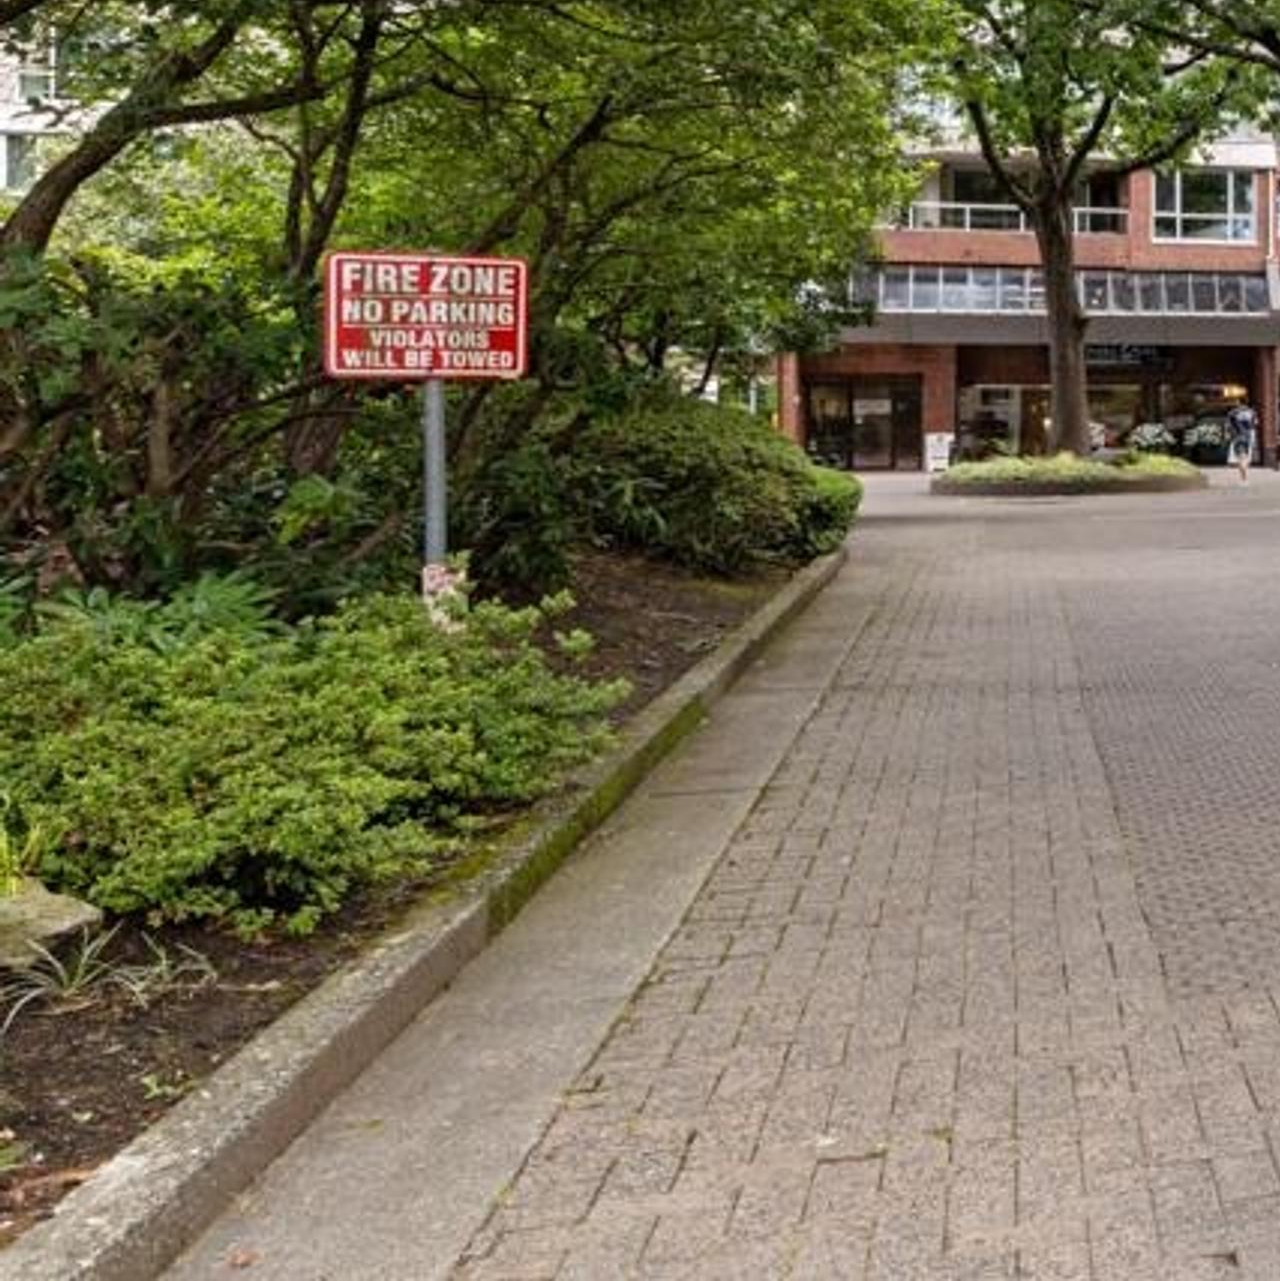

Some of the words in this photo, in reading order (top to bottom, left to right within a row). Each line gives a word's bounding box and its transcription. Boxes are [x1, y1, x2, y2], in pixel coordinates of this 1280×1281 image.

[341, 262, 421, 292] FIRE
[429, 263, 516, 295] ZONE
[341, 300, 384, 321] NO
[392, 301, 515, 326] PARKING
[369, 330, 491, 349] VIOLATORS
[341, 350, 400, 368] WILL
[404, 351, 434, 367] BE
[439, 352, 515, 369] TOWED
